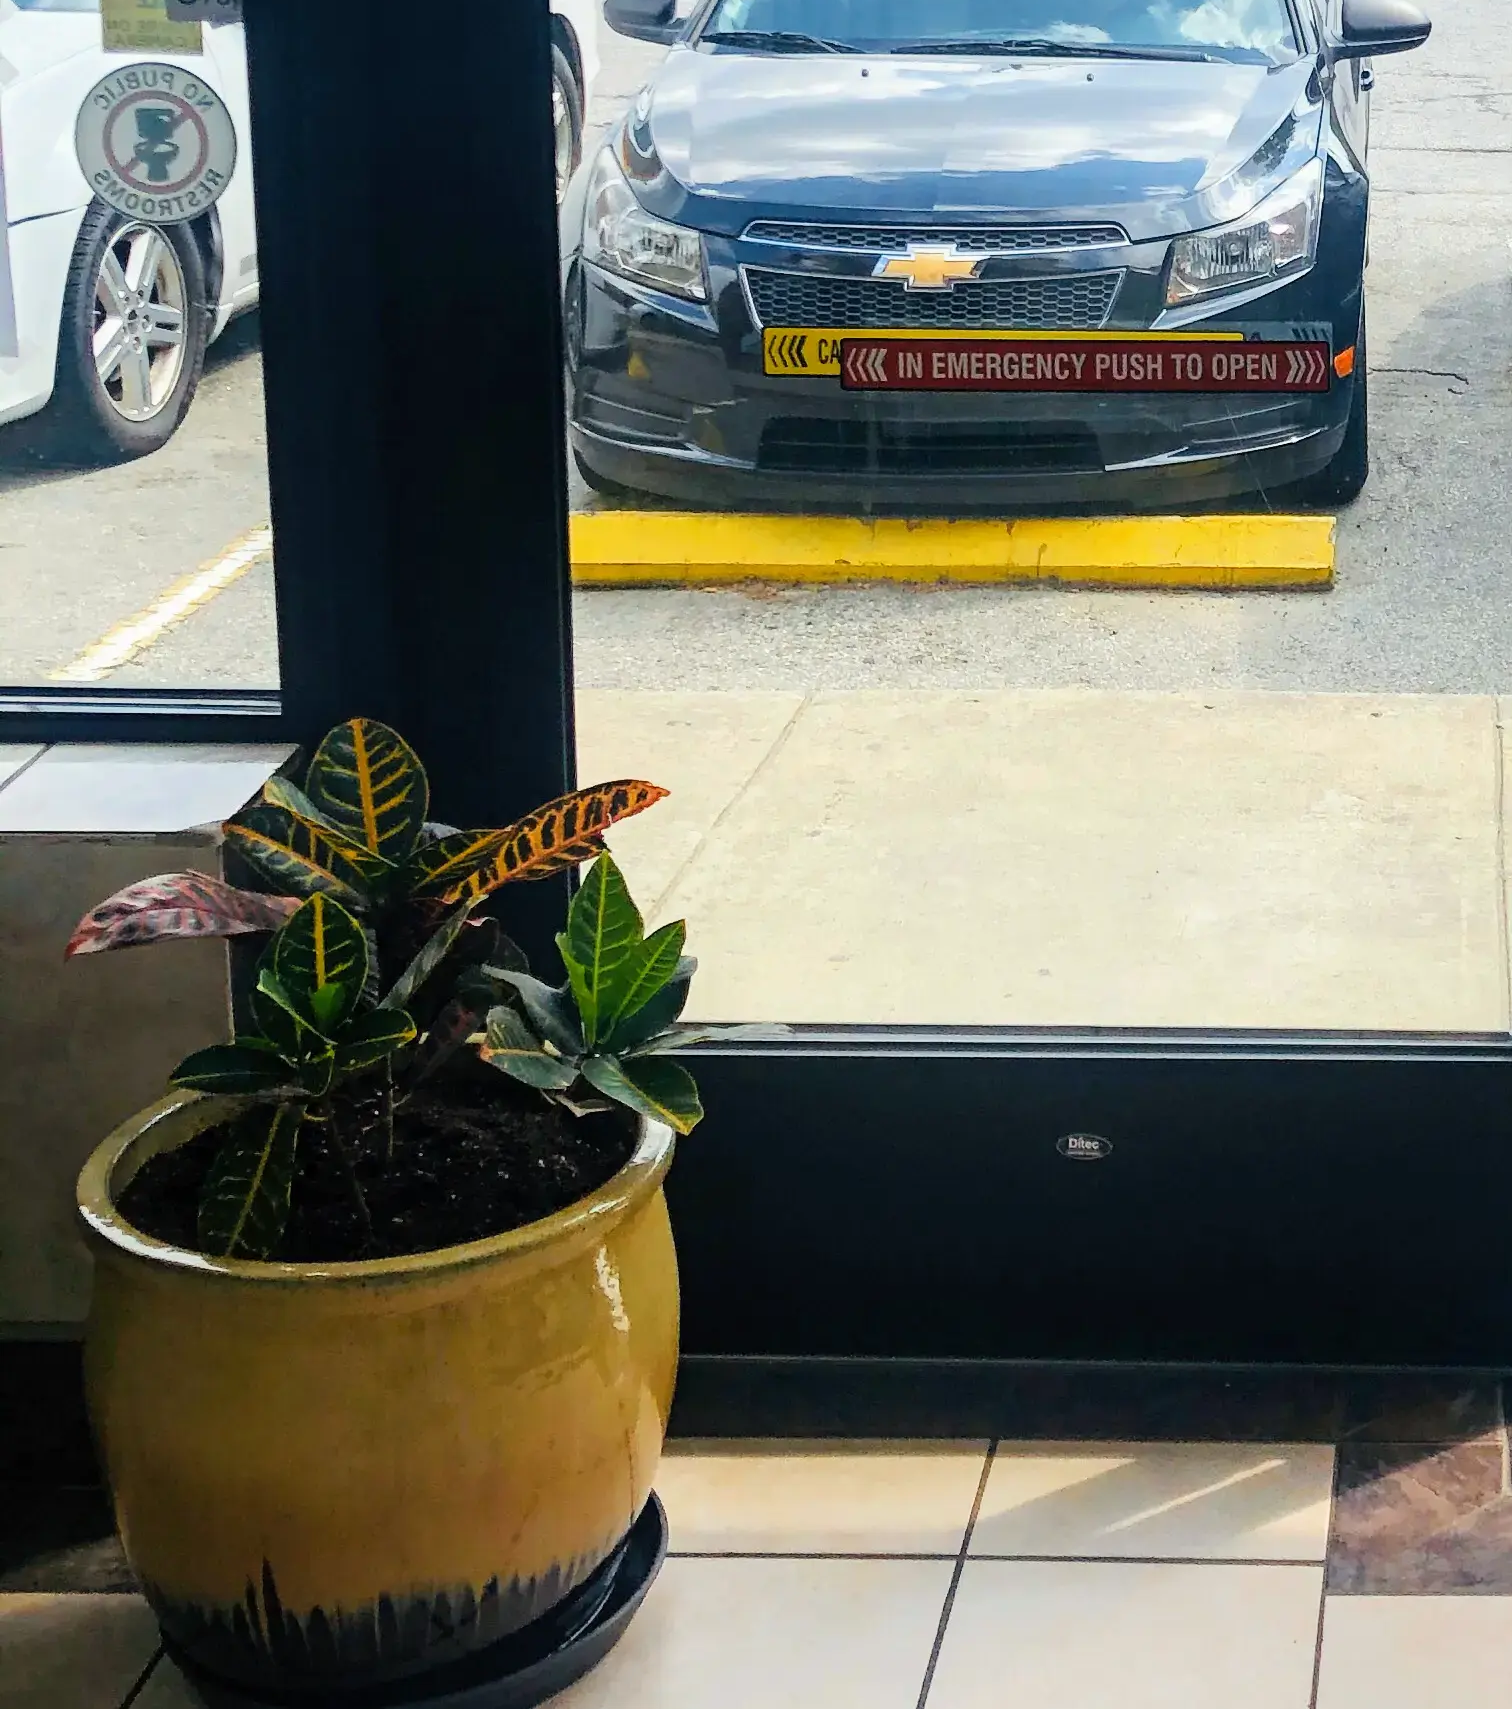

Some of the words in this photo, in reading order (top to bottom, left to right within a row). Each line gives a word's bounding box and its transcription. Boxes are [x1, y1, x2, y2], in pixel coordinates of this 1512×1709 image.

[898, 352, 923, 380] IN
[932, 352, 1087, 380] EMERGENCY
[1095, 352, 1163, 381] PUSH
[1170, 353, 1203, 381] TO
[1211, 353, 1277, 381] OPEN
